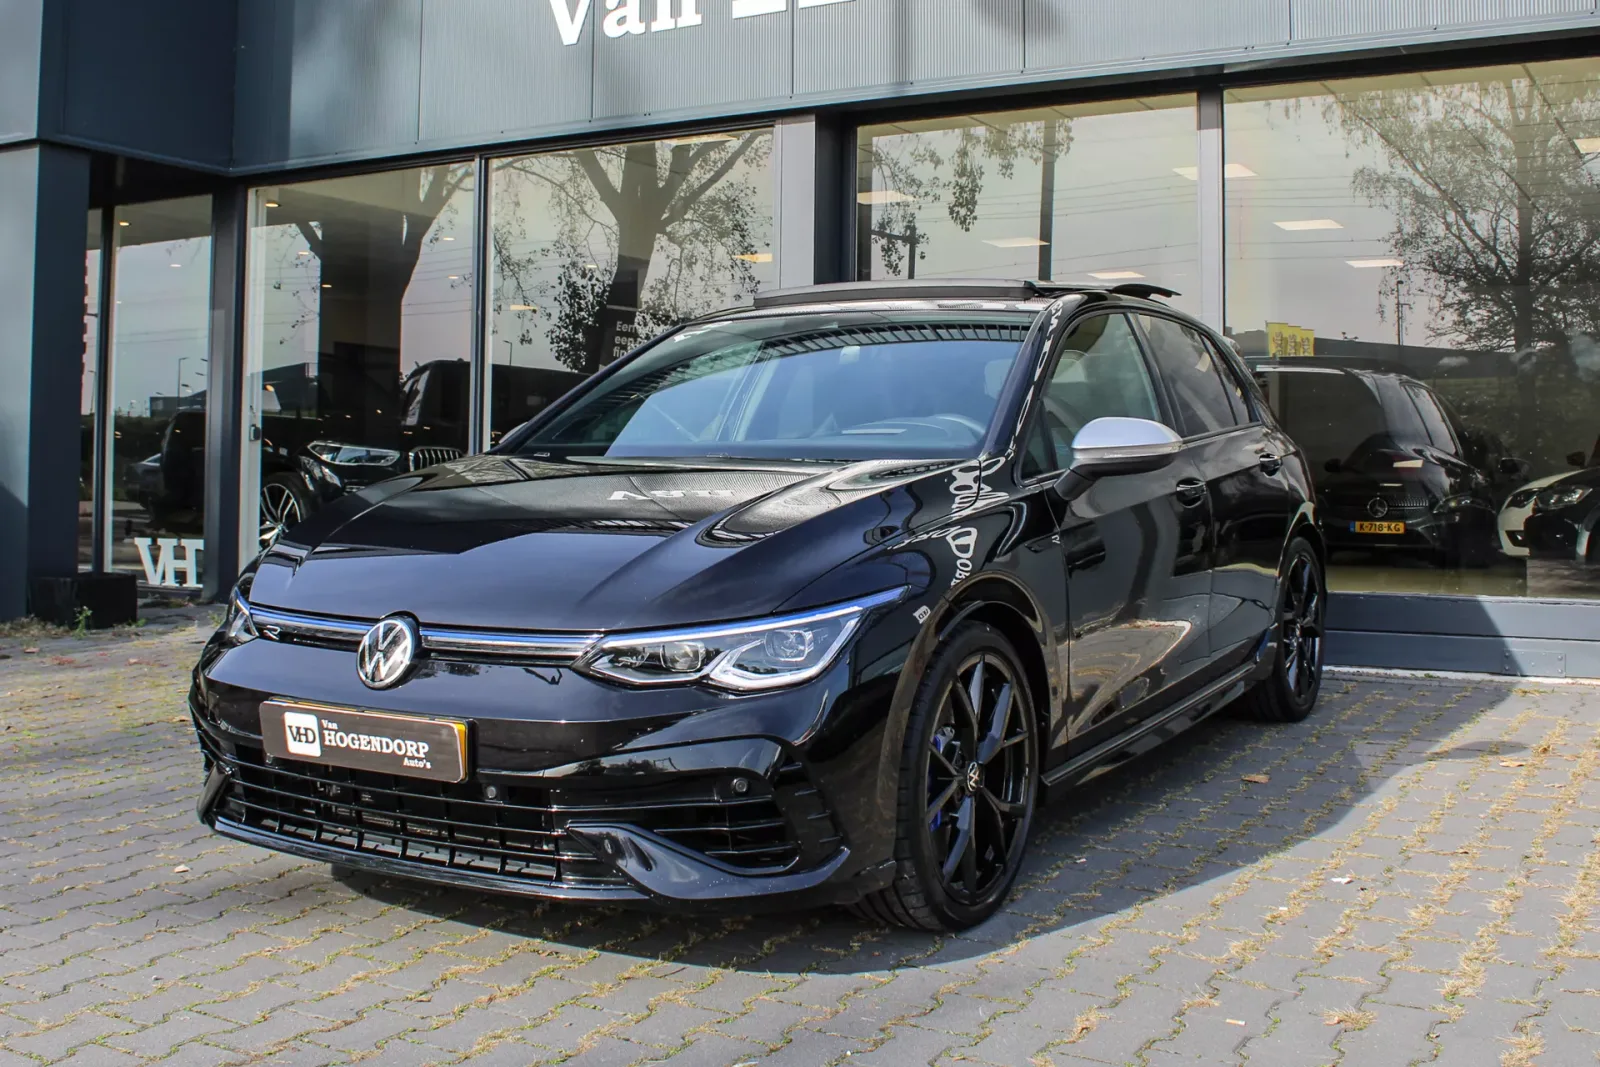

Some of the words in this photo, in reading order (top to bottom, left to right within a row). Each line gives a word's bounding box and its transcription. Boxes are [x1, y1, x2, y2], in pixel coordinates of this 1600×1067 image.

[1358, 522, 1401, 533] K-718-KG
[322, 719, 337, 730] Van
[286, 724, 318, 745] VHD
[323, 729, 430, 757] HOGENDORP
[403, 757, 431, 769] Auto's
